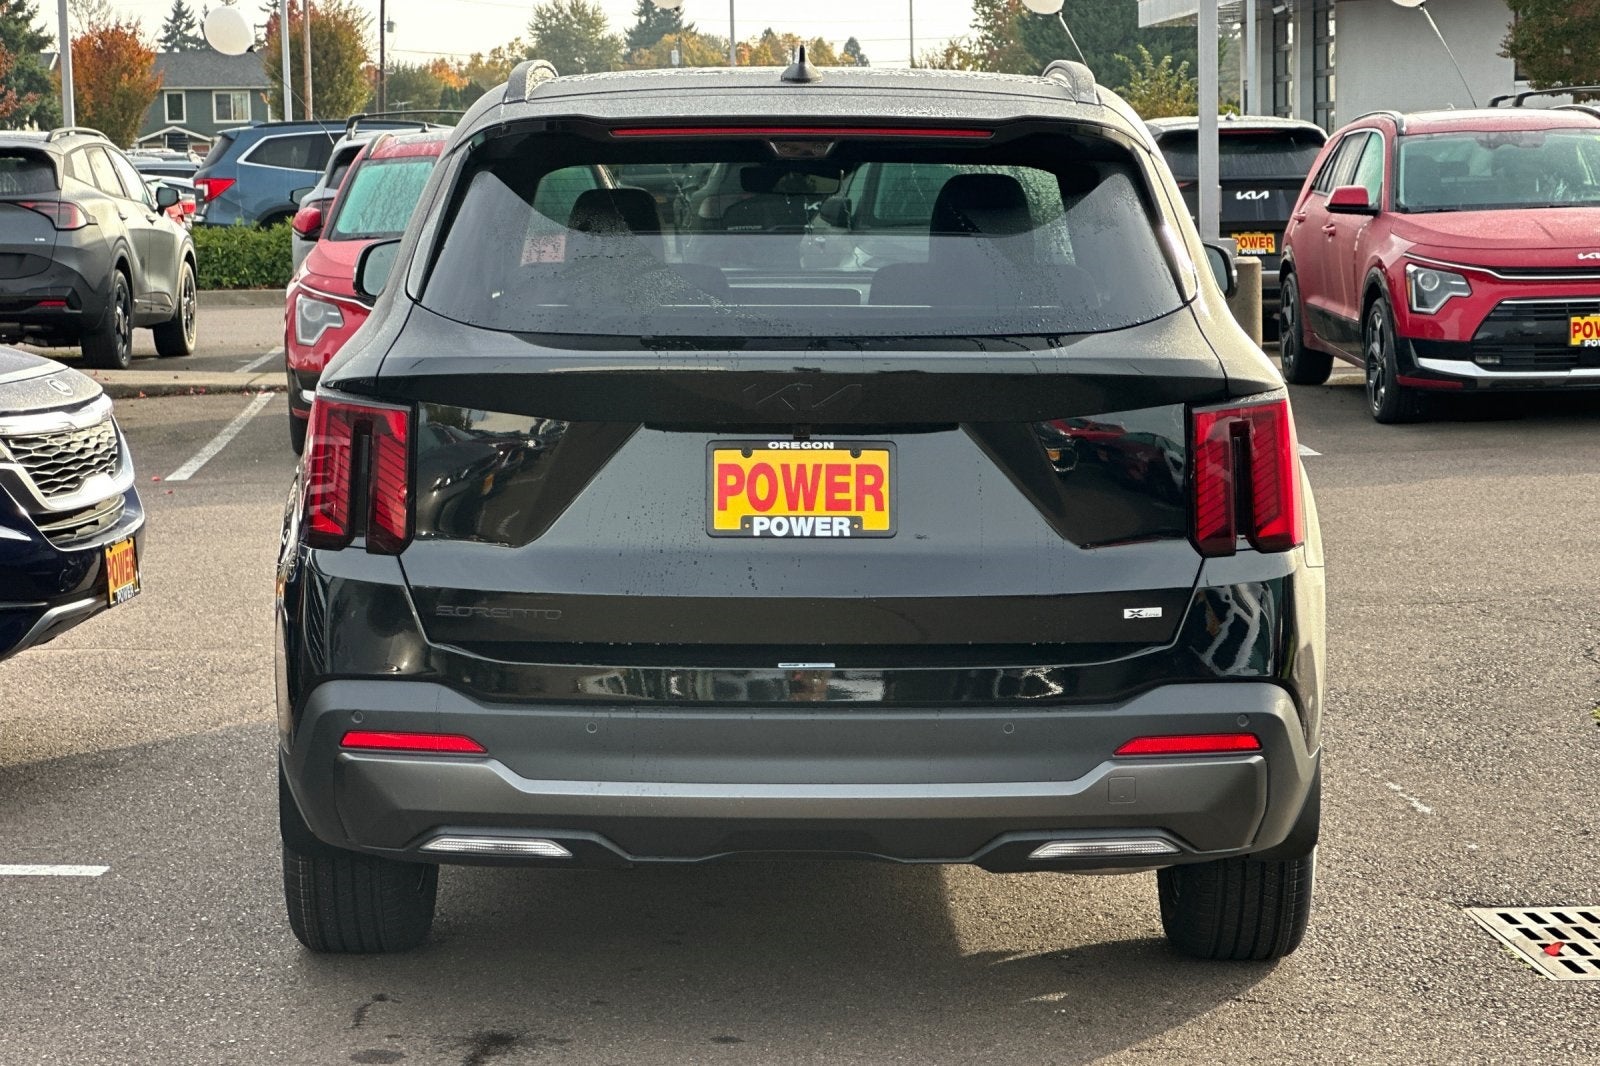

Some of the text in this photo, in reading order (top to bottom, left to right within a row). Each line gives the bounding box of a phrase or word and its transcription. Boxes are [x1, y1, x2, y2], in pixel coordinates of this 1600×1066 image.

[1236, 190, 1269, 200] KIA
[1233, 236, 1273, 248] POWER
[767, 441, 834, 450] OREGON
[717, 462, 885, 512] POWER
[753, 516, 851, 537] POWER
[106, 547, 135, 588] POWER
[436, 605, 562, 620] SORENTO
